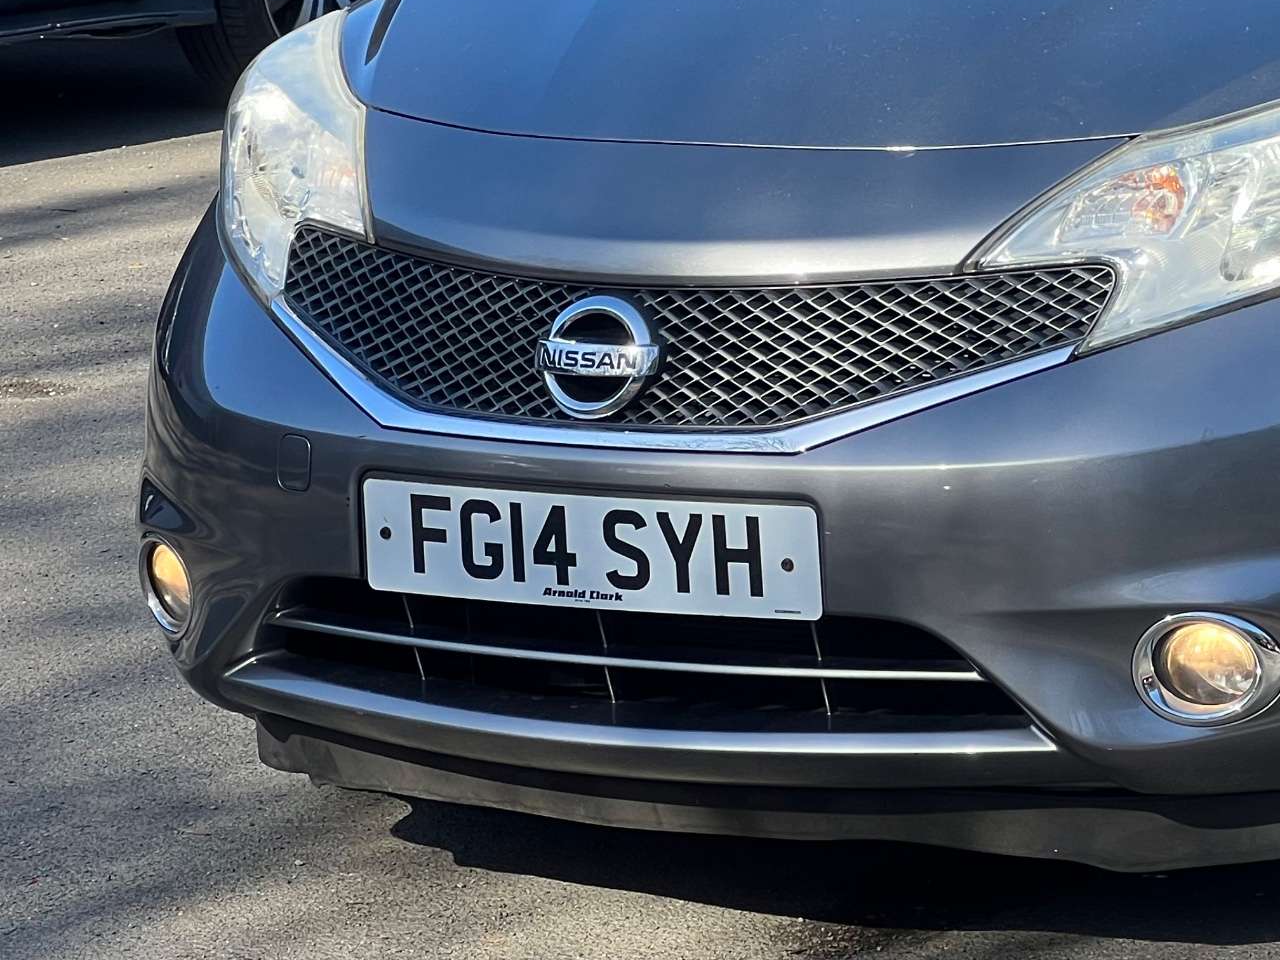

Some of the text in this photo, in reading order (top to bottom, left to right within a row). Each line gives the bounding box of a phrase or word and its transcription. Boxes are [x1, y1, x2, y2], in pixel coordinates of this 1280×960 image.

[540, 343, 637, 370] NISSAN
[410, 493, 765, 598] FG14 SYH
[543, 587, 623, 602] Arnold Clark
